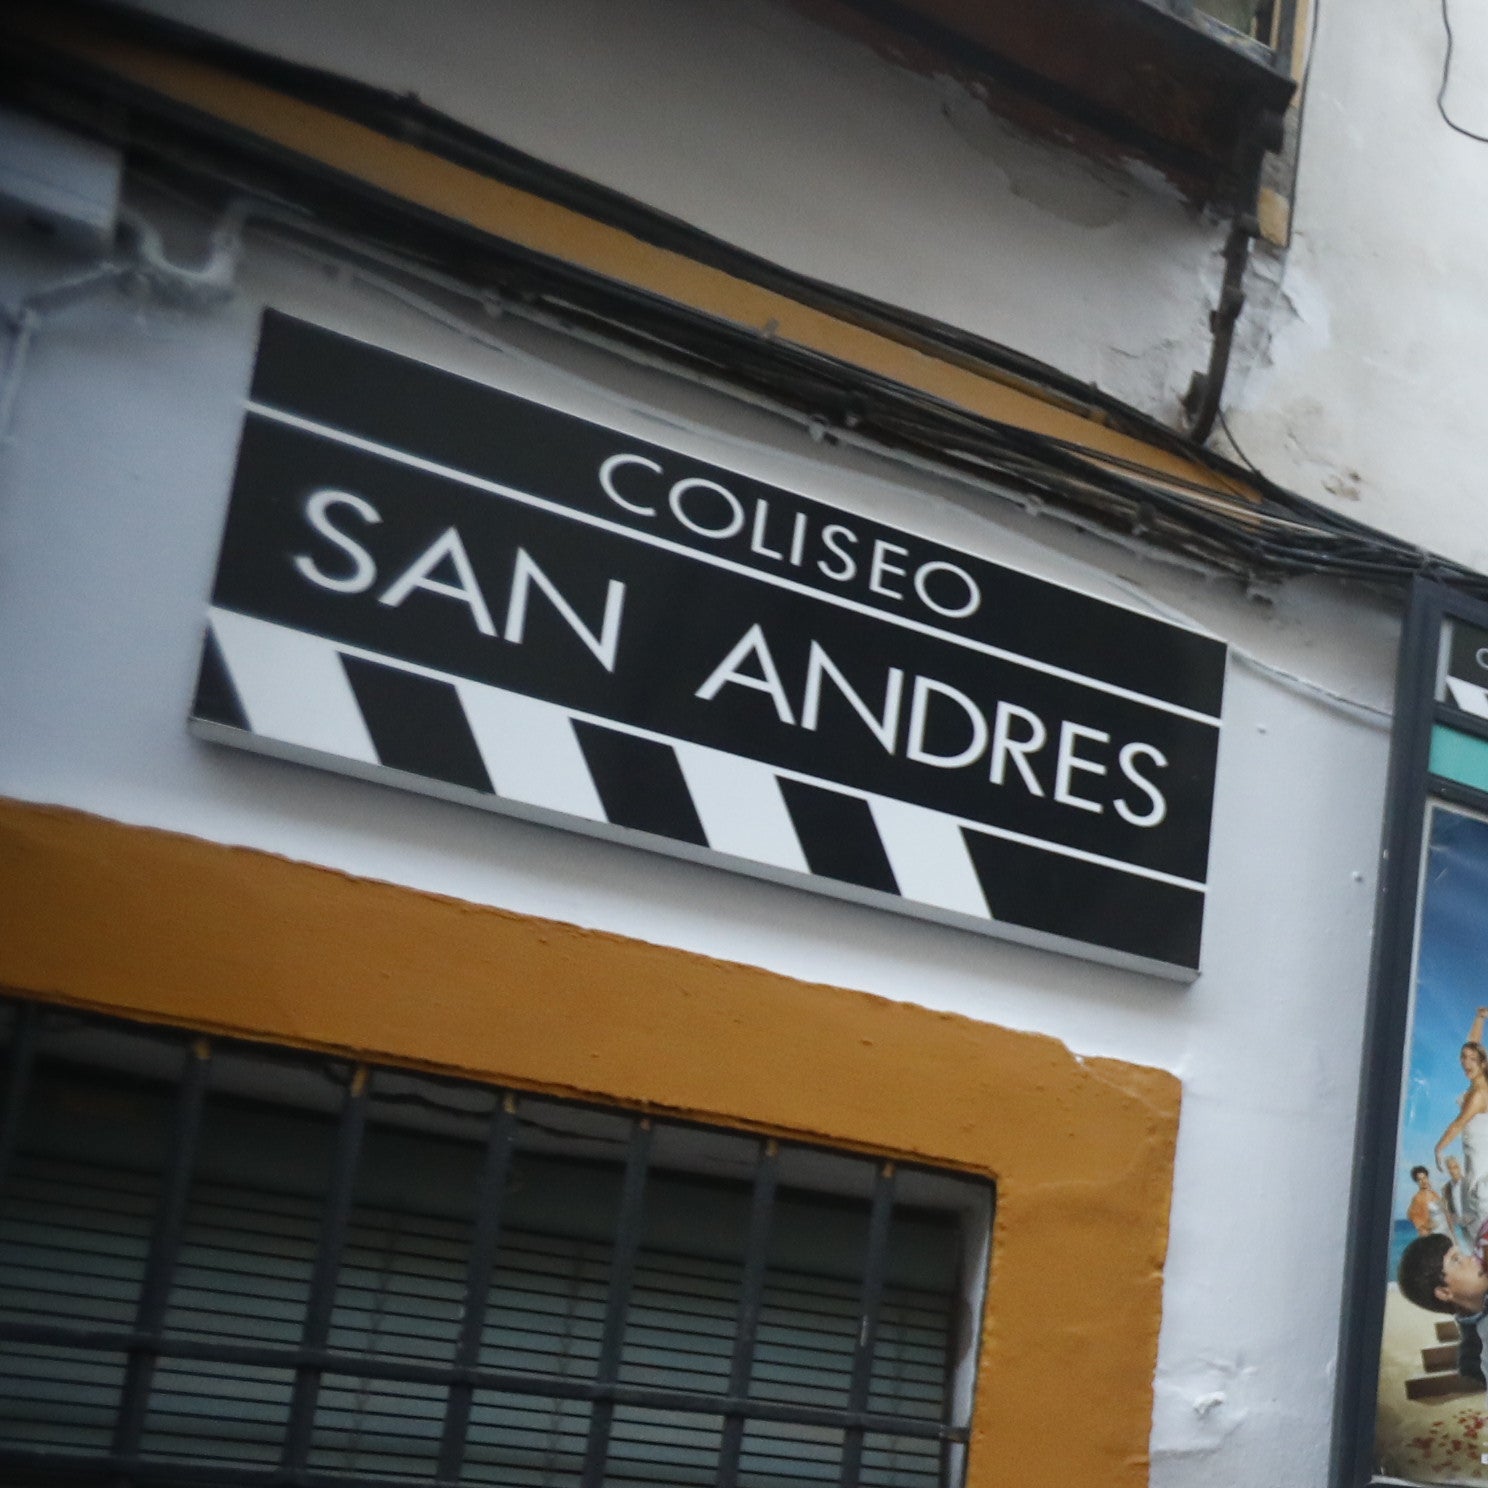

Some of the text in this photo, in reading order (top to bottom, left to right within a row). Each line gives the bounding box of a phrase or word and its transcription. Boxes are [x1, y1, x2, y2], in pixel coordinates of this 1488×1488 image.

[293, 487, 1169, 829] SAN ANDRES
[598, 452, 982, 619] COLISEO
